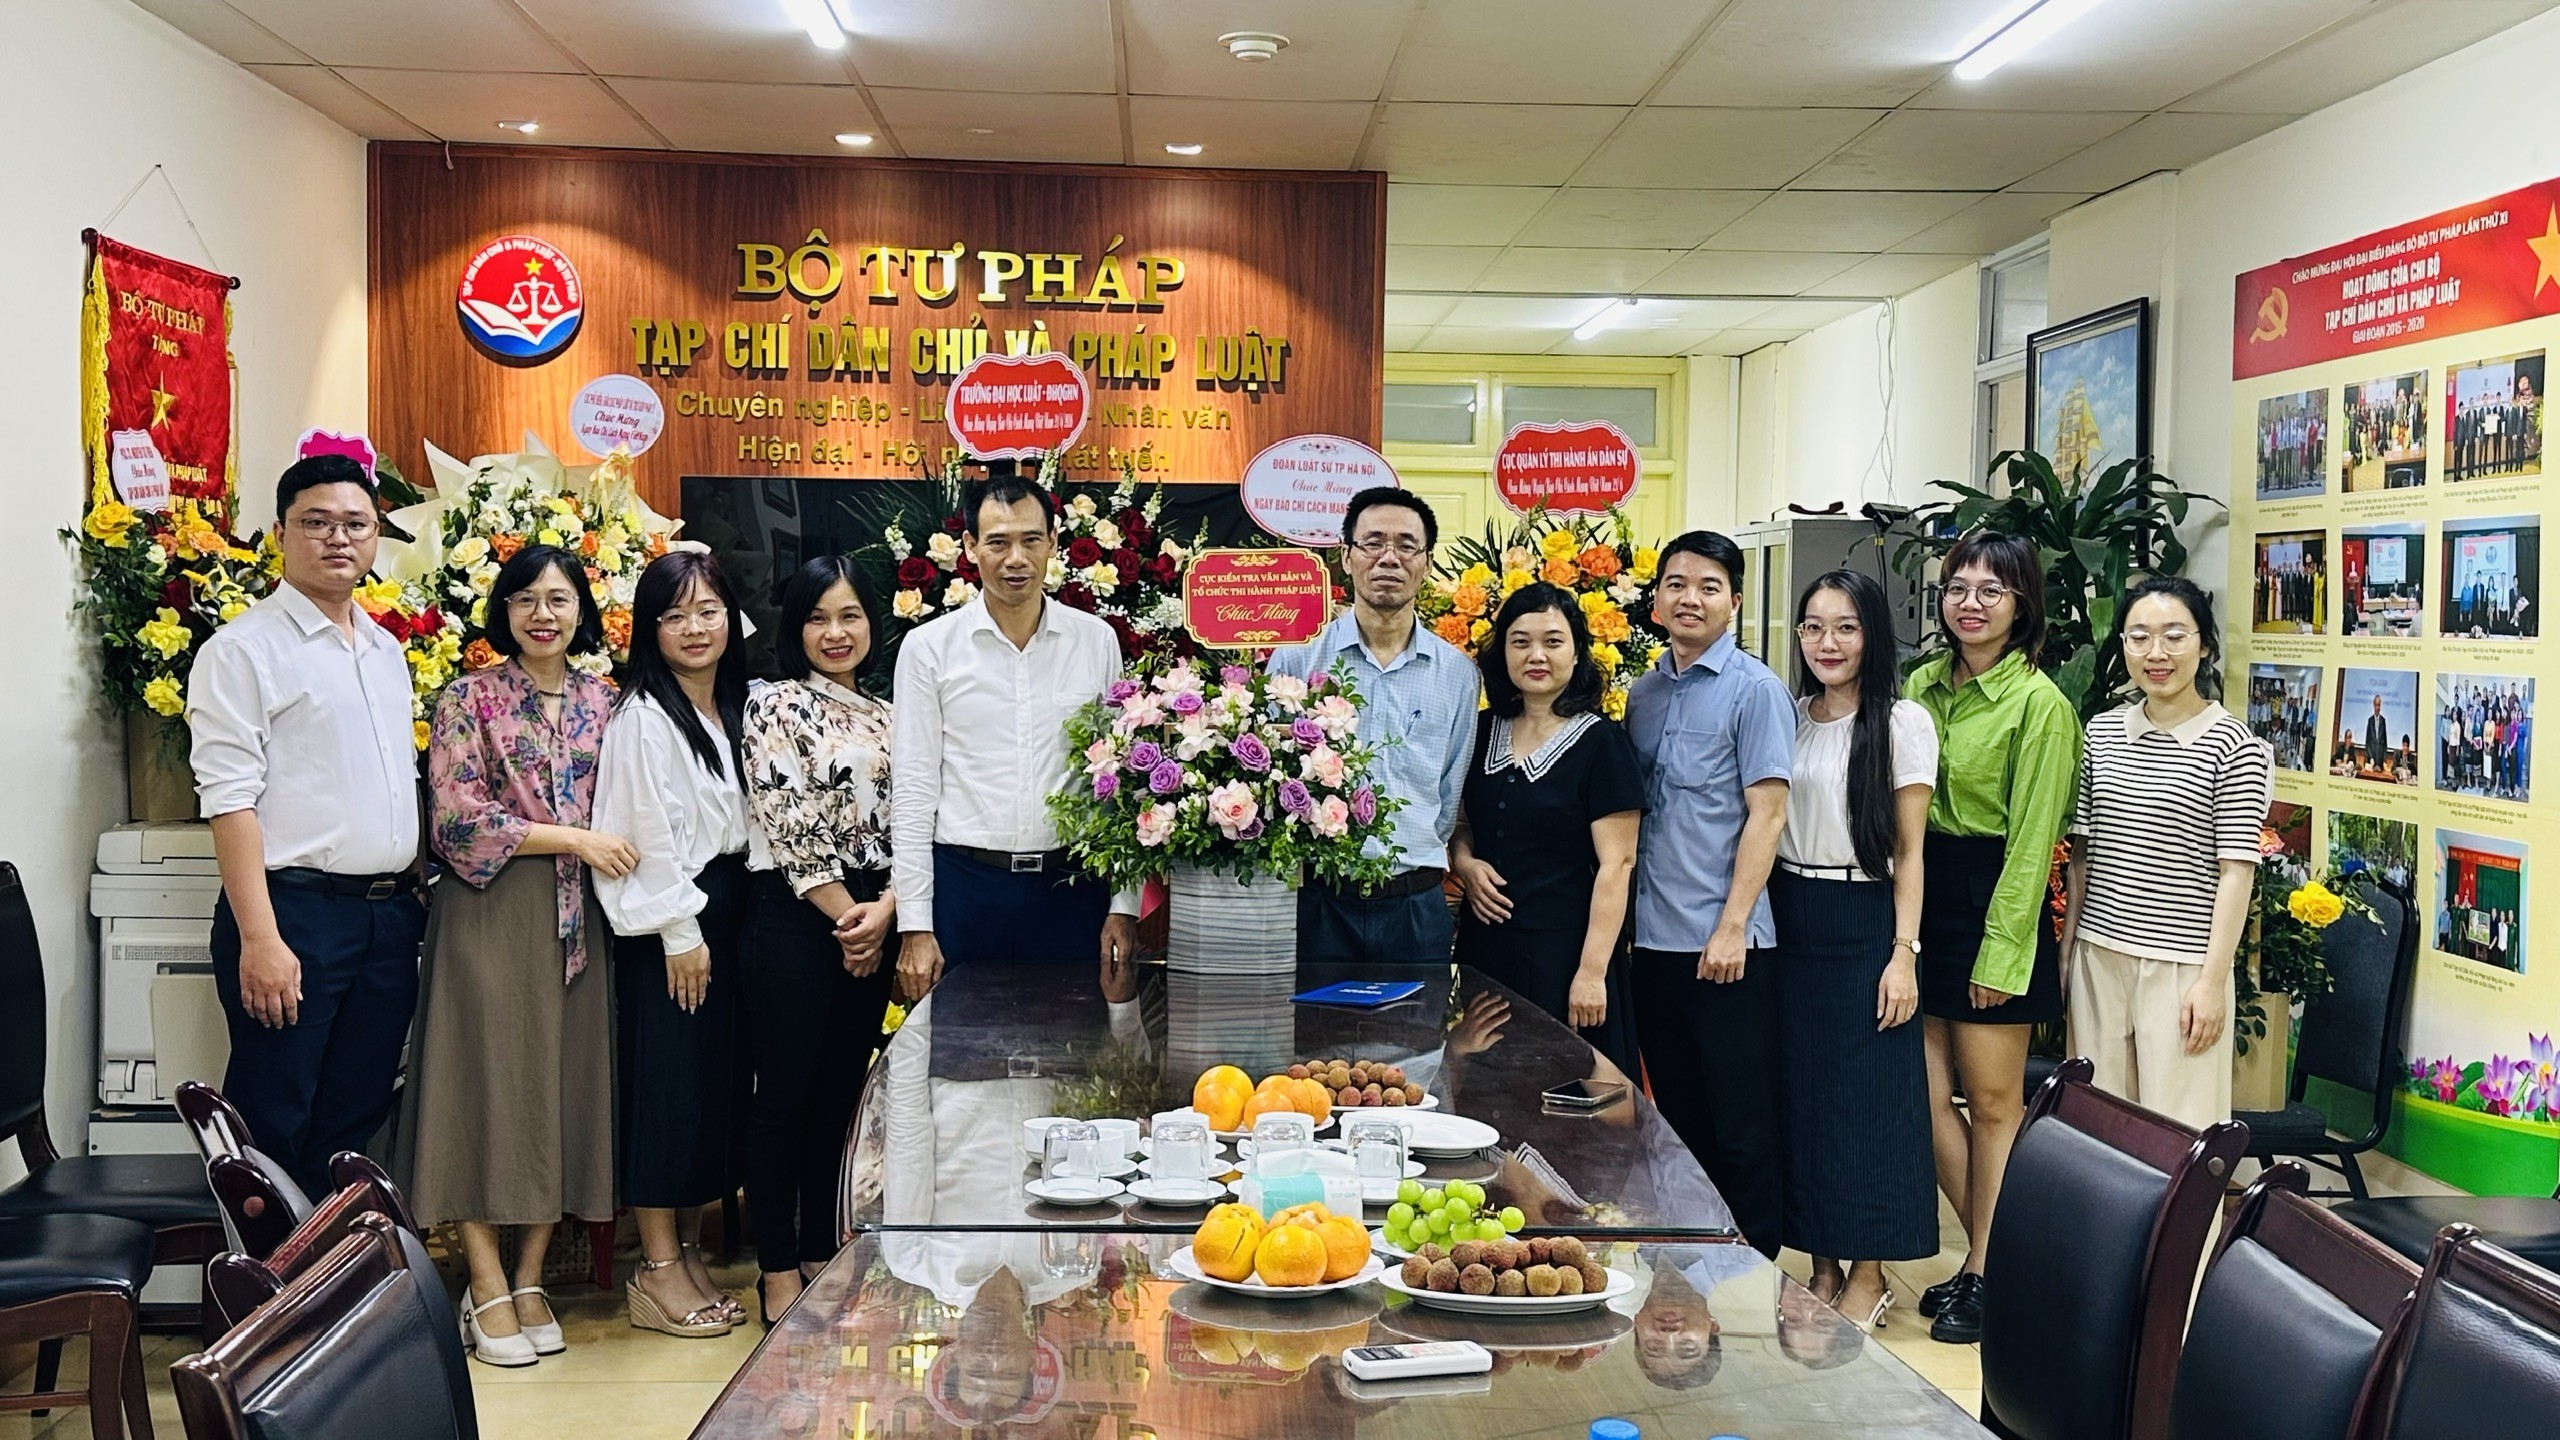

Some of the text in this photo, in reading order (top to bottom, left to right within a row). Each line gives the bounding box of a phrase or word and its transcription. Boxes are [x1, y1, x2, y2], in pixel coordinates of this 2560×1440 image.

[2311, 262, 2330, 279] MỪNG
[2343, 254, 2355, 271] HỘI
[2440, 222, 2462, 242] PHÁP
[2499, 210, 2509, 226] XI
[737, 228, 1186, 312] BỘ TƯ PHÁP
[2342, 251, 2441, 302] HOẠT ĐỘNG CỦA CHI BỘ
[120, 290, 144, 320] BỘ
[165, 309, 205, 337] PHÁP
[2325, 276, 2461, 334] TẠP CHÍ DÂN CHỦ VÀ PHÁP LUẬT
[2386, 320, 2402, 337] 2015
[2406, 315, 2425, 333] 2020
[630, 317, 706, 376] TẠP
[724, 313, 793, 369] CHÍ
[808, 314, 890, 373] DÂN
[909, 312, 988, 375] CHỦ
[1073, 323, 1178, 380] PHÁP
[1195, 325, 1288, 391] LUẬT
[960, 380, 992, 405] TRƯỜNG
[992, 384, 1007, 408] ĐẠI
[1007, 384, 1023, 408] HỌC
[1023, 379, 1043, 407] LUẬT
[676, 390, 784, 422] Chuyên
[794, 396, 891, 427] nghiệp
[1101, 402, 1173, 430] Nhân
[1182, 409, 1232, 431] văn
[737, 434, 801, 468] Hiện
[811, 438, 853, 468] đại
[1502, 445, 1629, 473] CỤC QUẢN LÝ THI HÀNH ÁN DÂN SỰ
[1272, 457, 1376, 477] ĐOÀN LUẬT SƯ TP HÀ NỘI
[1292, 479, 1353, 496] Chúc Mừng
[1254, 497, 1273, 511] NGÀY
[1275, 496, 1290, 512] BÁO
[1307, 499, 1327, 513] CÁCH
[1329, 501, 1348, 516] MẠN
[1192, 584, 1322, 597] TỔ CHỨC THI HÀNH PHÁP LUẬT
[1199, 570, 1313, 586] CỤC KIỂM TRA VĂN BẢN VÀ
[1216, 602, 1301, 626] Chúc Mừng
